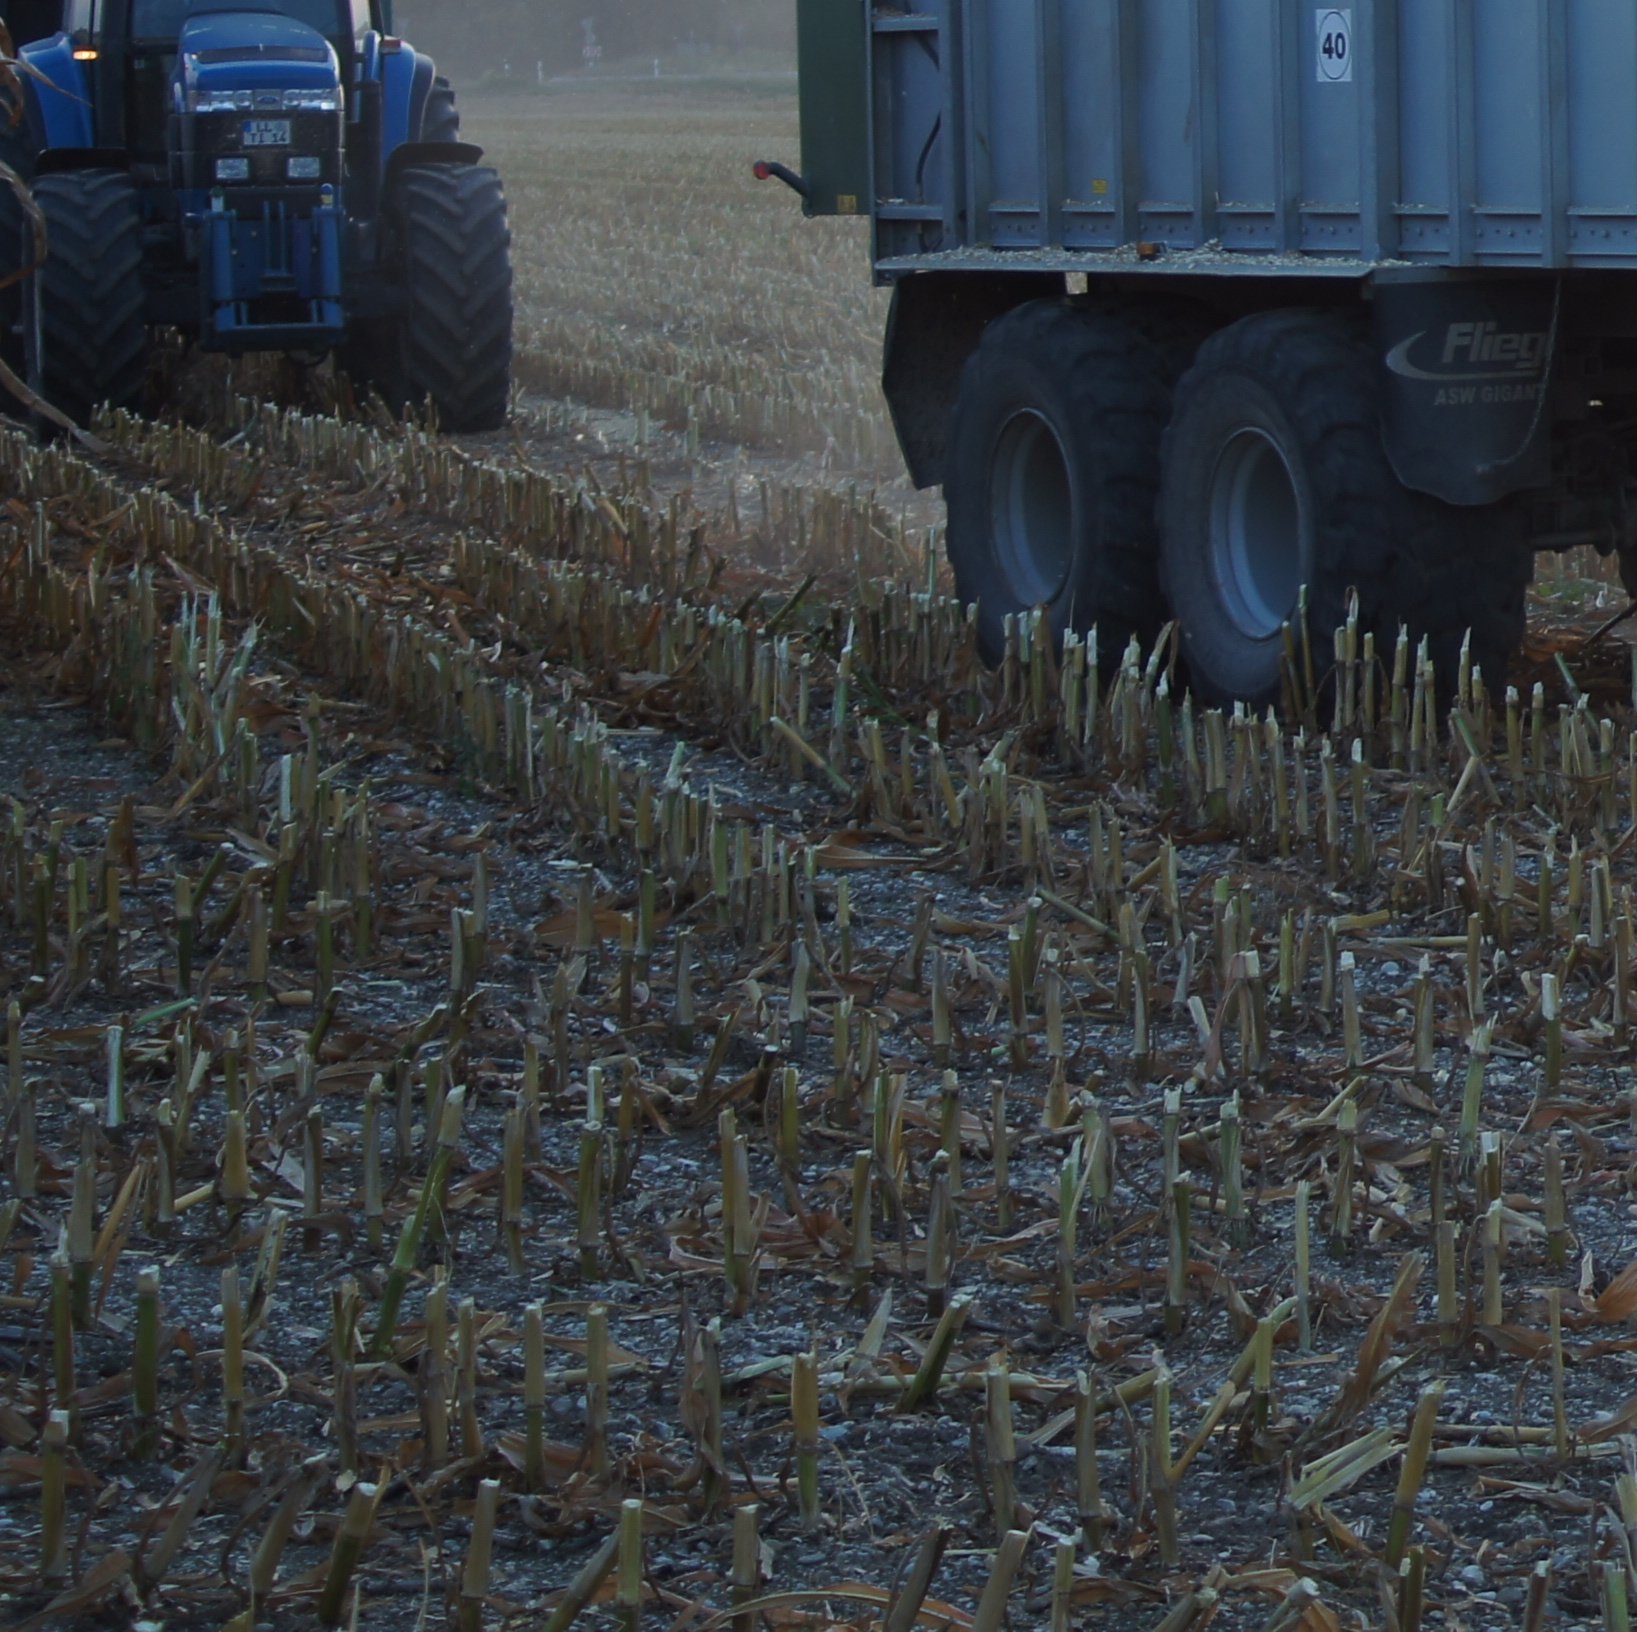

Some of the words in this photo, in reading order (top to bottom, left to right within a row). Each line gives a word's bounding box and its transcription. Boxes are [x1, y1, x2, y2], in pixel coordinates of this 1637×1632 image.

[1322, 32, 1346, 60] 40
[256, 121, 272, 132] LL
[1434, 384, 1476, 407] ASW
